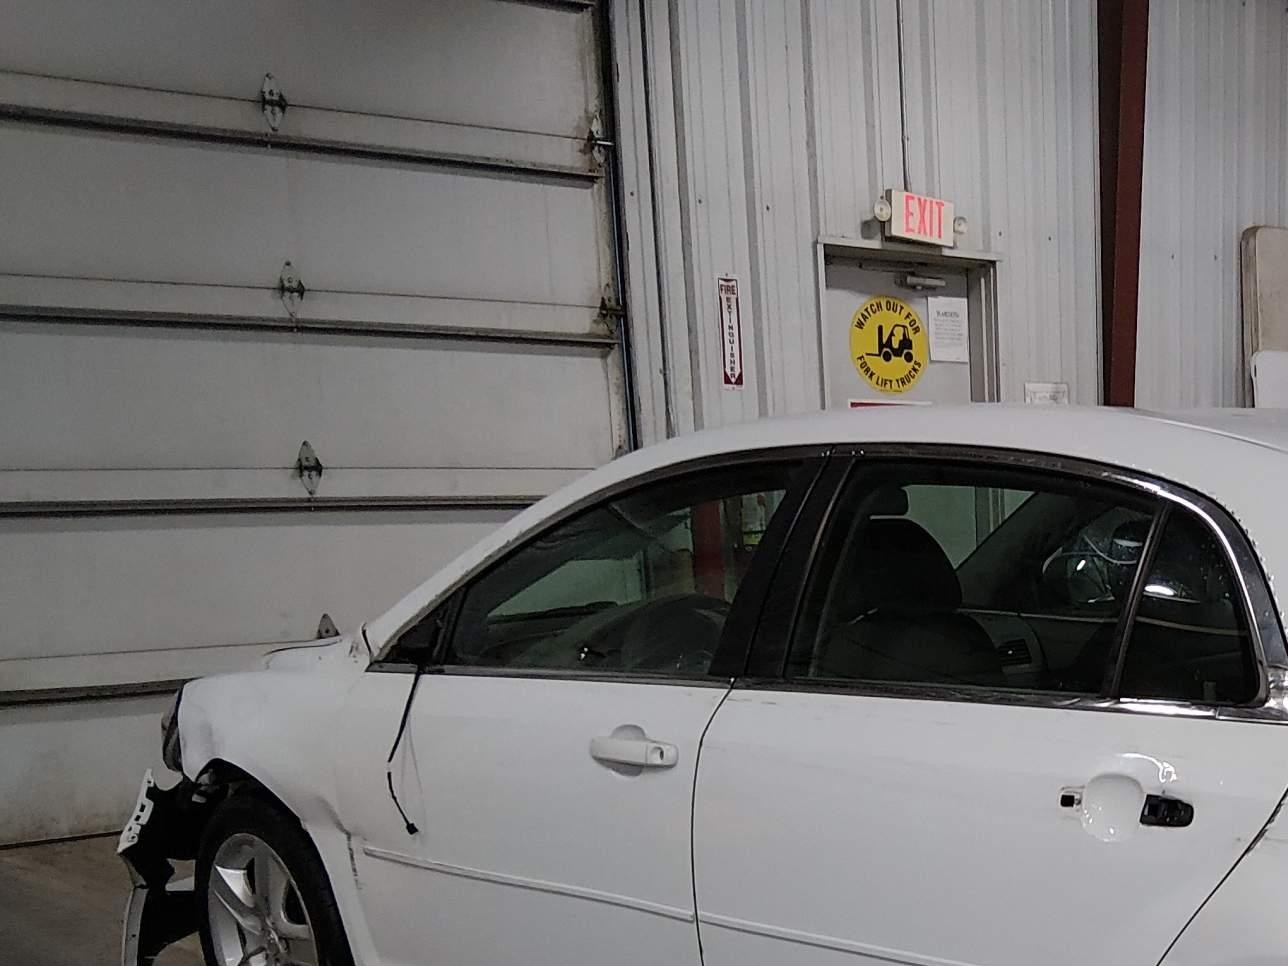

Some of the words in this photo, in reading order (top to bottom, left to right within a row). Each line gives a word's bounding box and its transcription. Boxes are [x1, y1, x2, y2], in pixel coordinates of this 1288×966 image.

[904, 194, 944, 239] EXIT
[719, 283, 736, 295] FIRE
[854, 299, 883, 330] WATCH
[885, 300, 904, 315] OUT
[904, 312, 921, 335] FOR
[856, 355, 876, 381] FORK
[876, 375, 893, 390] LIFT
[896, 360, 922, 389] TRUCKS
